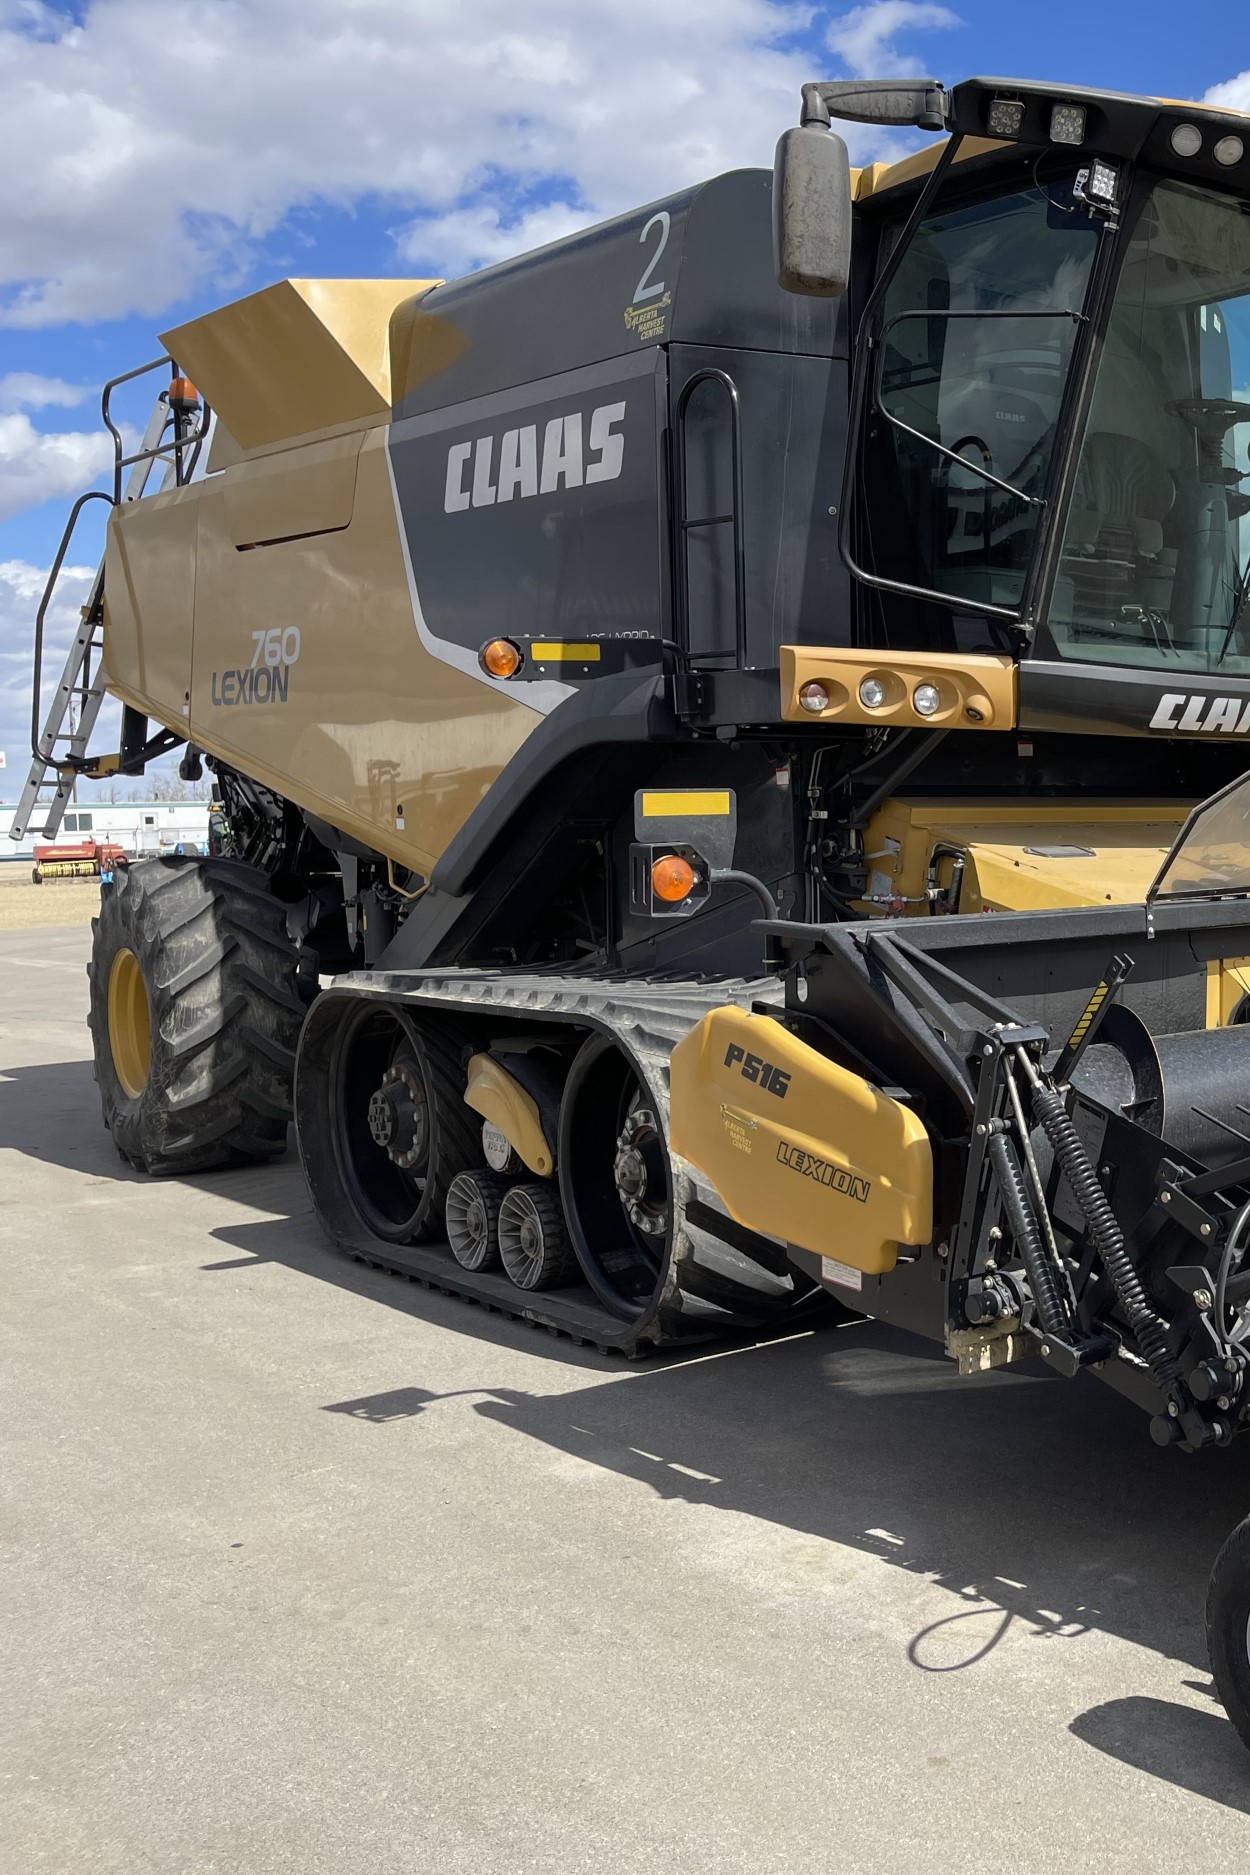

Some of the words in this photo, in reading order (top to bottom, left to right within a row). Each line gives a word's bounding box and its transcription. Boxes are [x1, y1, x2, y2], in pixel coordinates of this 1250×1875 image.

[632, 210, 671, 304] 2
[632, 309, 658, 330] ALBERTA
[638, 315, 666, 333] HARVEST
[640, 324, 665, 341] CENTRE
[995, 411, 1026, 423] CLAAS
[444, 401, 626, 514] CLAAS
[250, 625, 301, 668] 760
[211, 665, 290, 706] LEXION
[723, 1042, 792, 1099] P516
[724, 1120, 746, 1136] ALBERTA
[729, 1131, 752, 1146] HARVEST
[732, 1139, 752, 1155] CENTRE
[776, 1140, 872, 1203] LEXION
